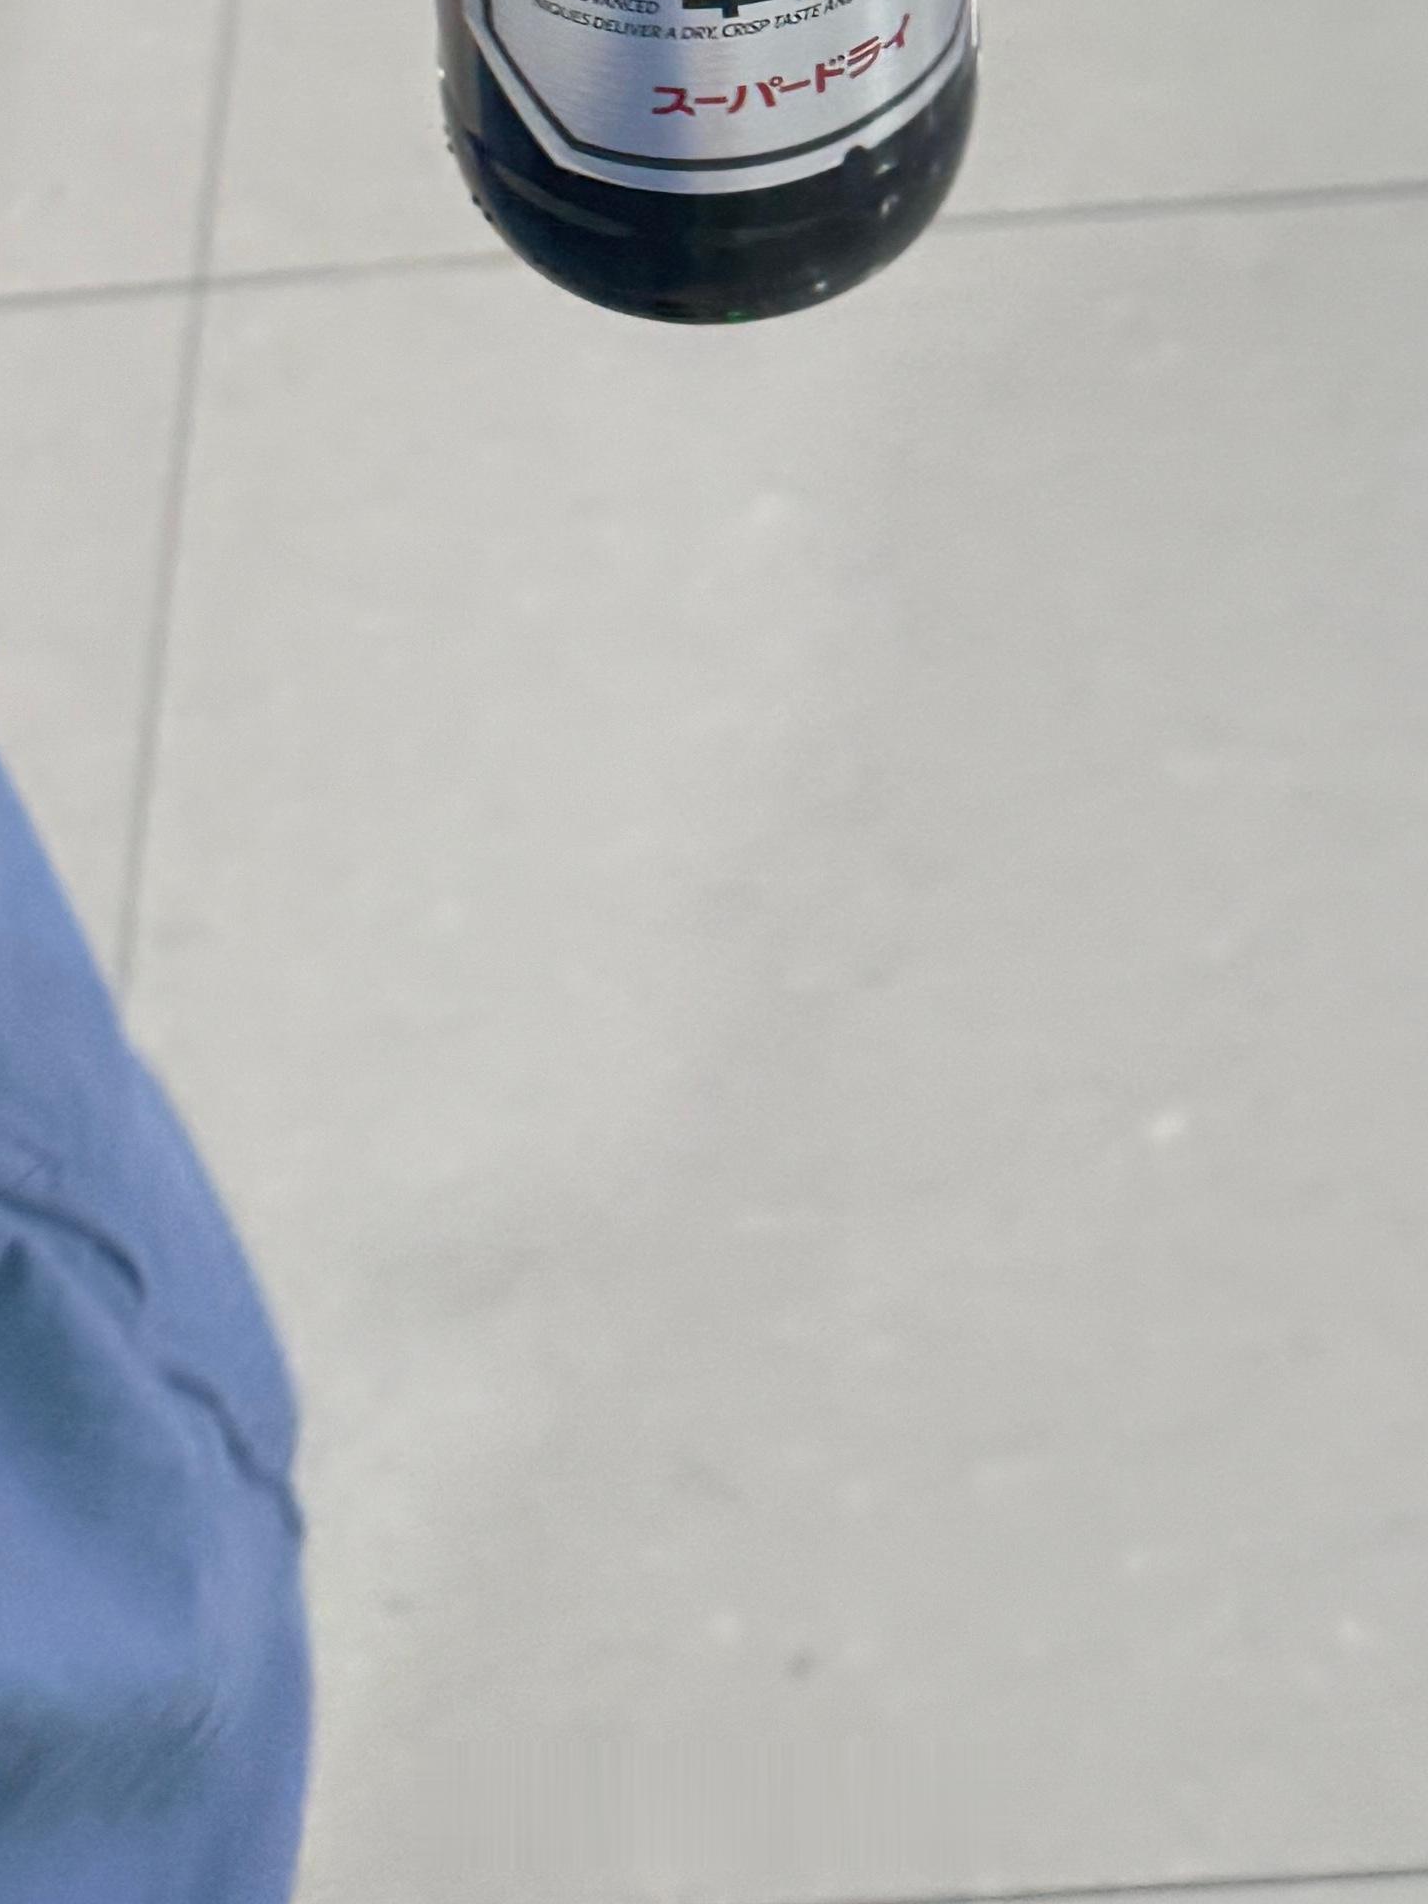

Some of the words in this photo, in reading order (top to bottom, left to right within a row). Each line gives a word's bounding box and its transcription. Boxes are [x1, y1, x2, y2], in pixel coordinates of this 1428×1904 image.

[592, 15, 662, 39] DELIVER
[664, 26, 678, 40] A
[722, 18, 771, 38] CRISP
[773, 3, 823, 29] TASTE
[651, 12, 911, 117] スーパードライ
